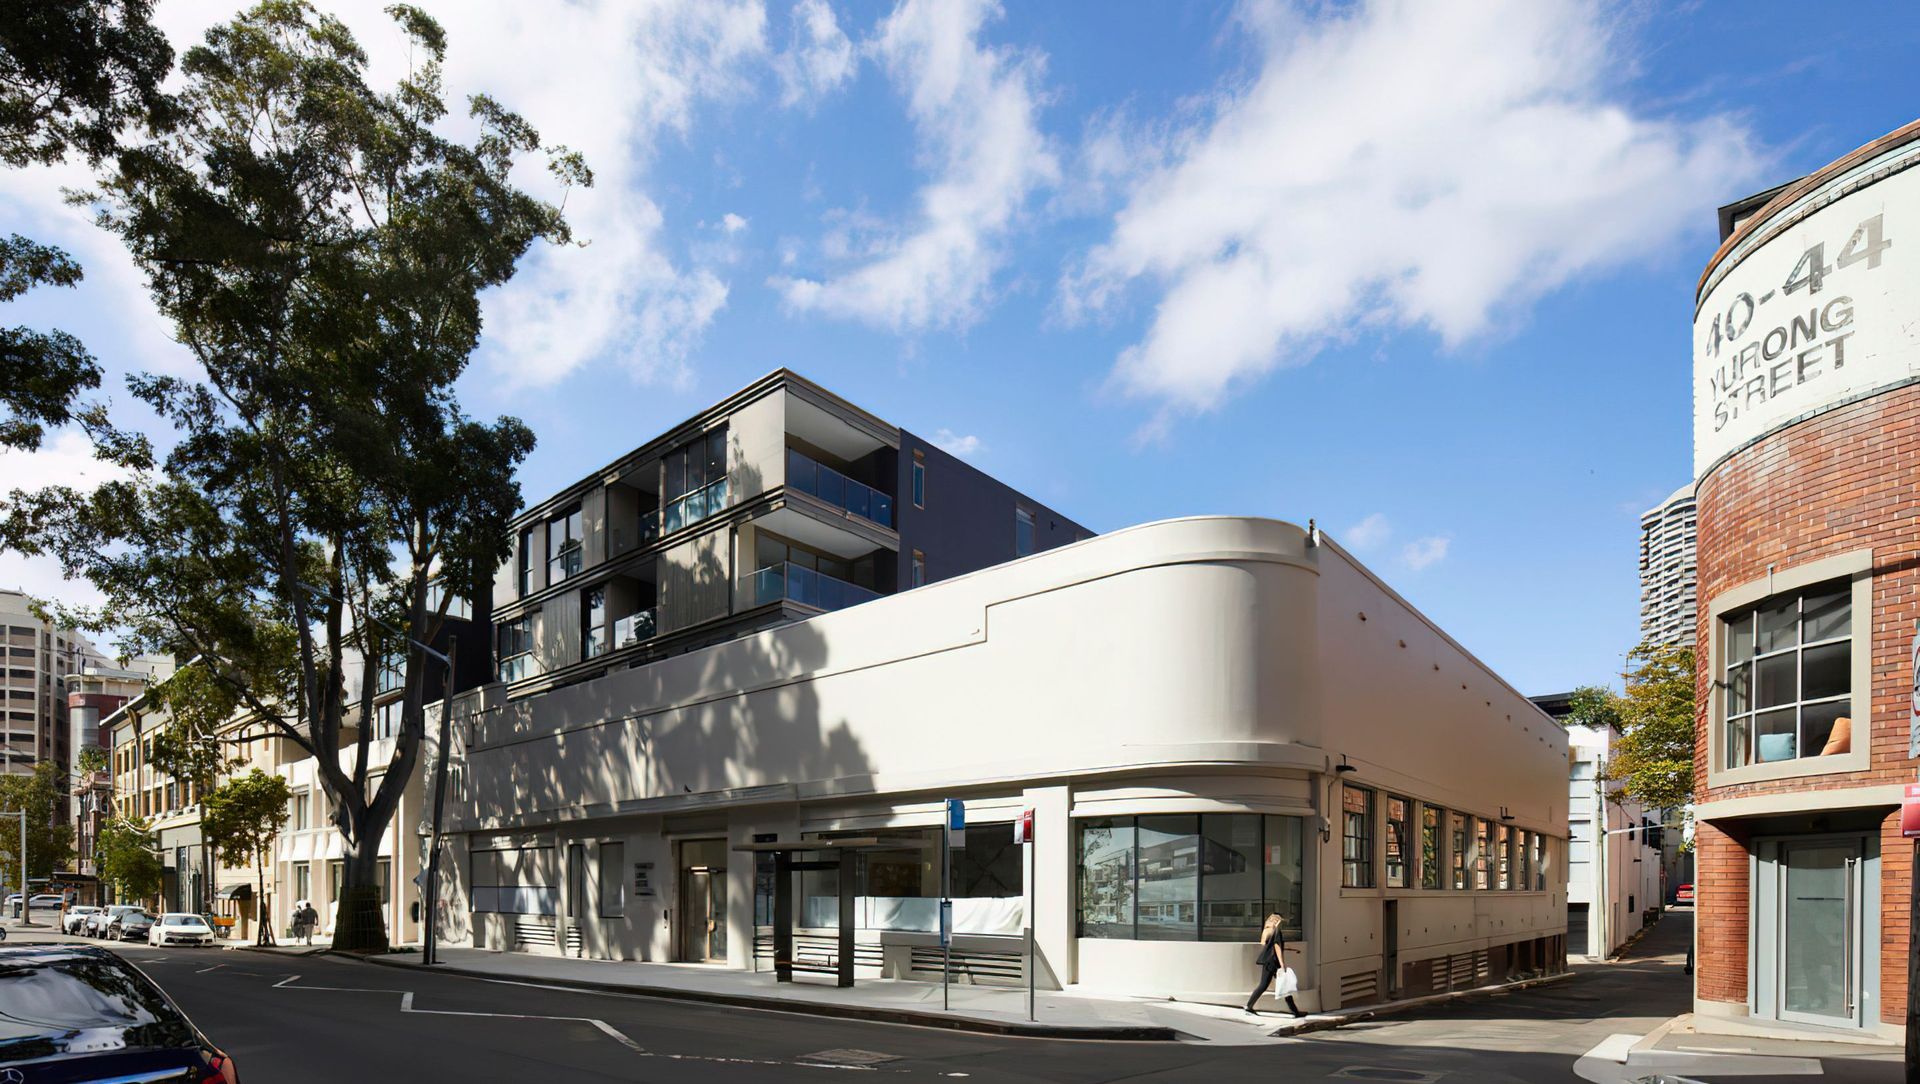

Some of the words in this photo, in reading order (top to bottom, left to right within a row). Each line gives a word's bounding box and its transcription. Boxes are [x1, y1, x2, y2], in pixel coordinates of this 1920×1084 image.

[1706, 213, 1892, 357] 40-44
[1710, 295, 1854, 401] YURONG
[1714, 330, 1855, 432] STREET
